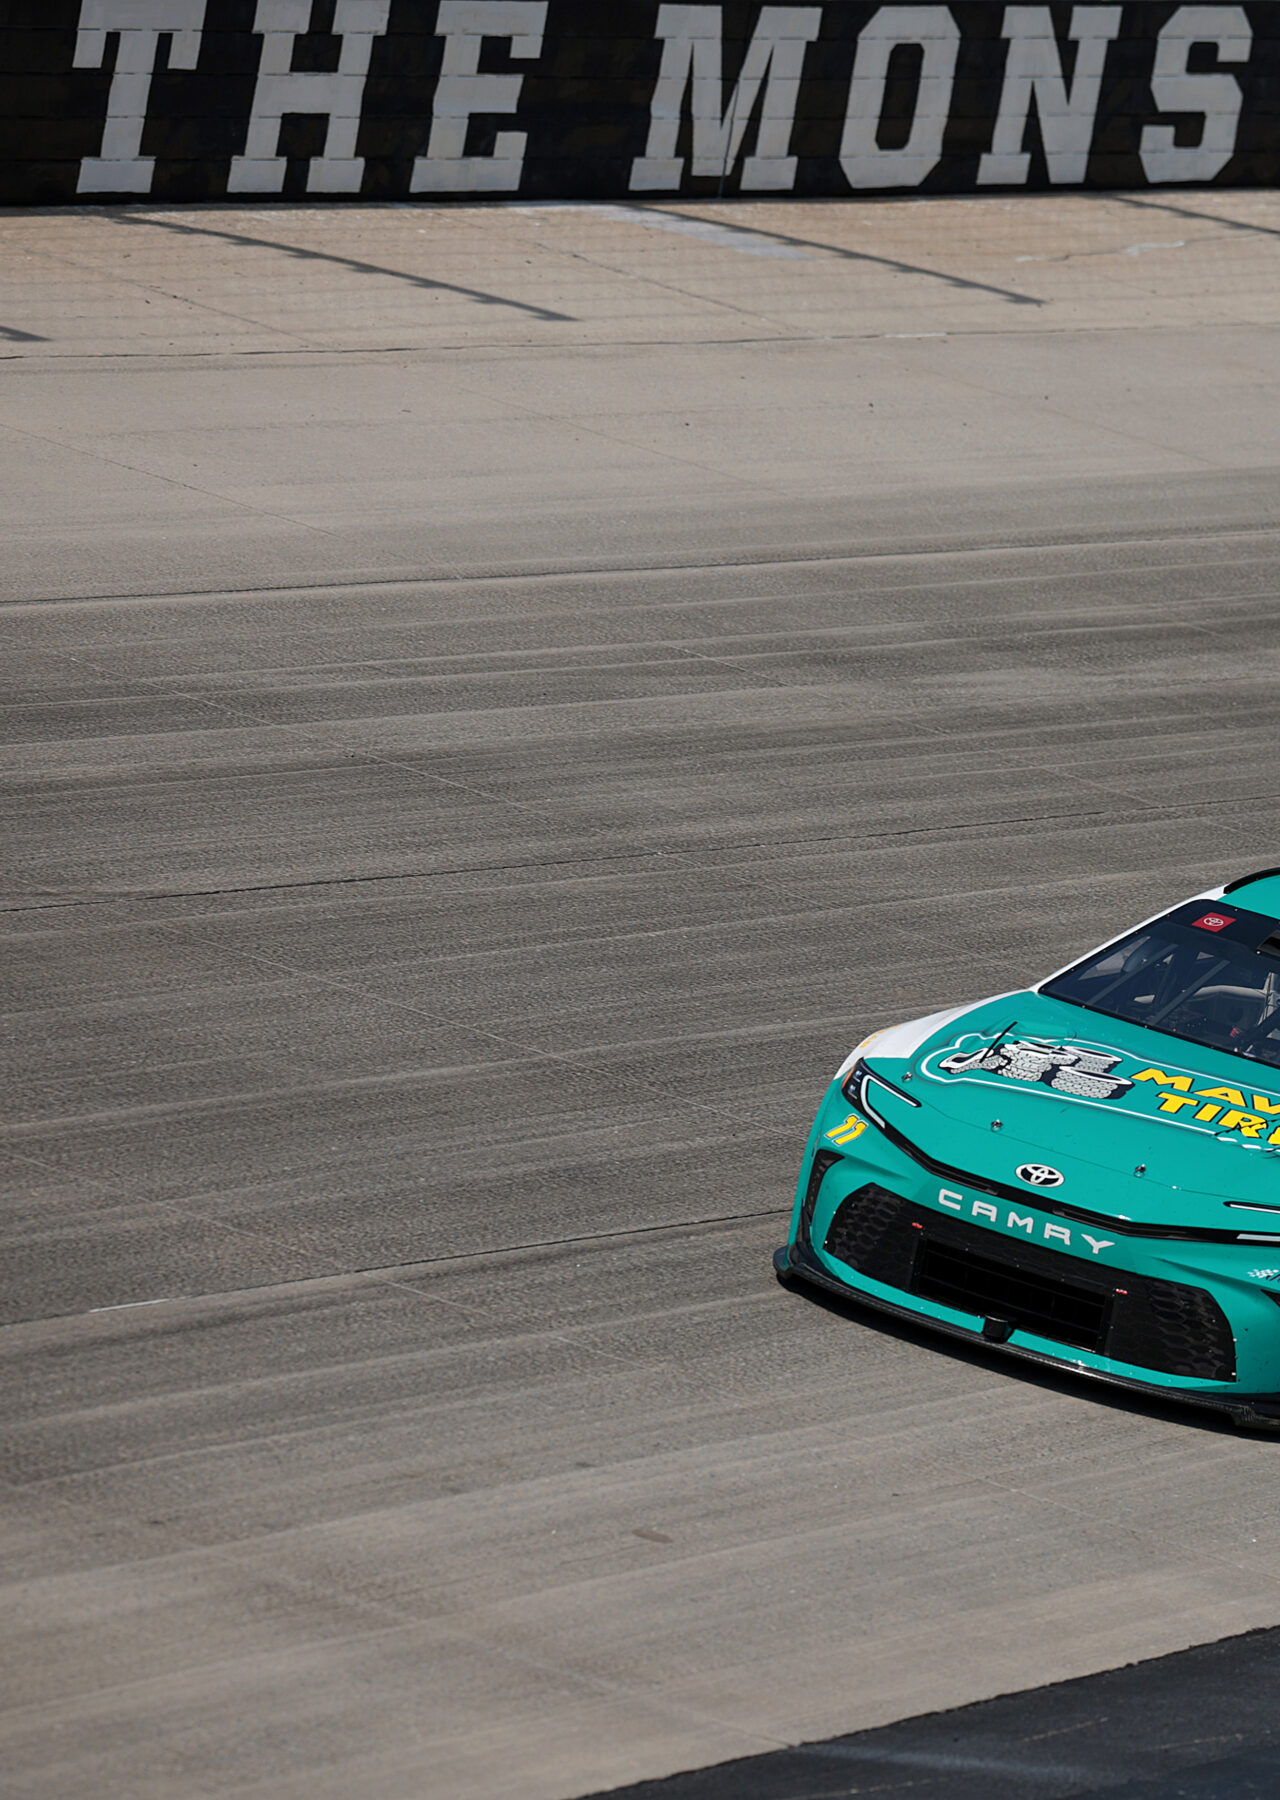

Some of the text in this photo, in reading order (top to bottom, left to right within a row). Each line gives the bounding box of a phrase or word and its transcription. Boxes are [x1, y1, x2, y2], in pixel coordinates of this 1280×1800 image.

[73, 0, 549, 192] THE
[824, 1113, 869, 1146] 11
[938, 1188, 1115, 1254] CAMRY
